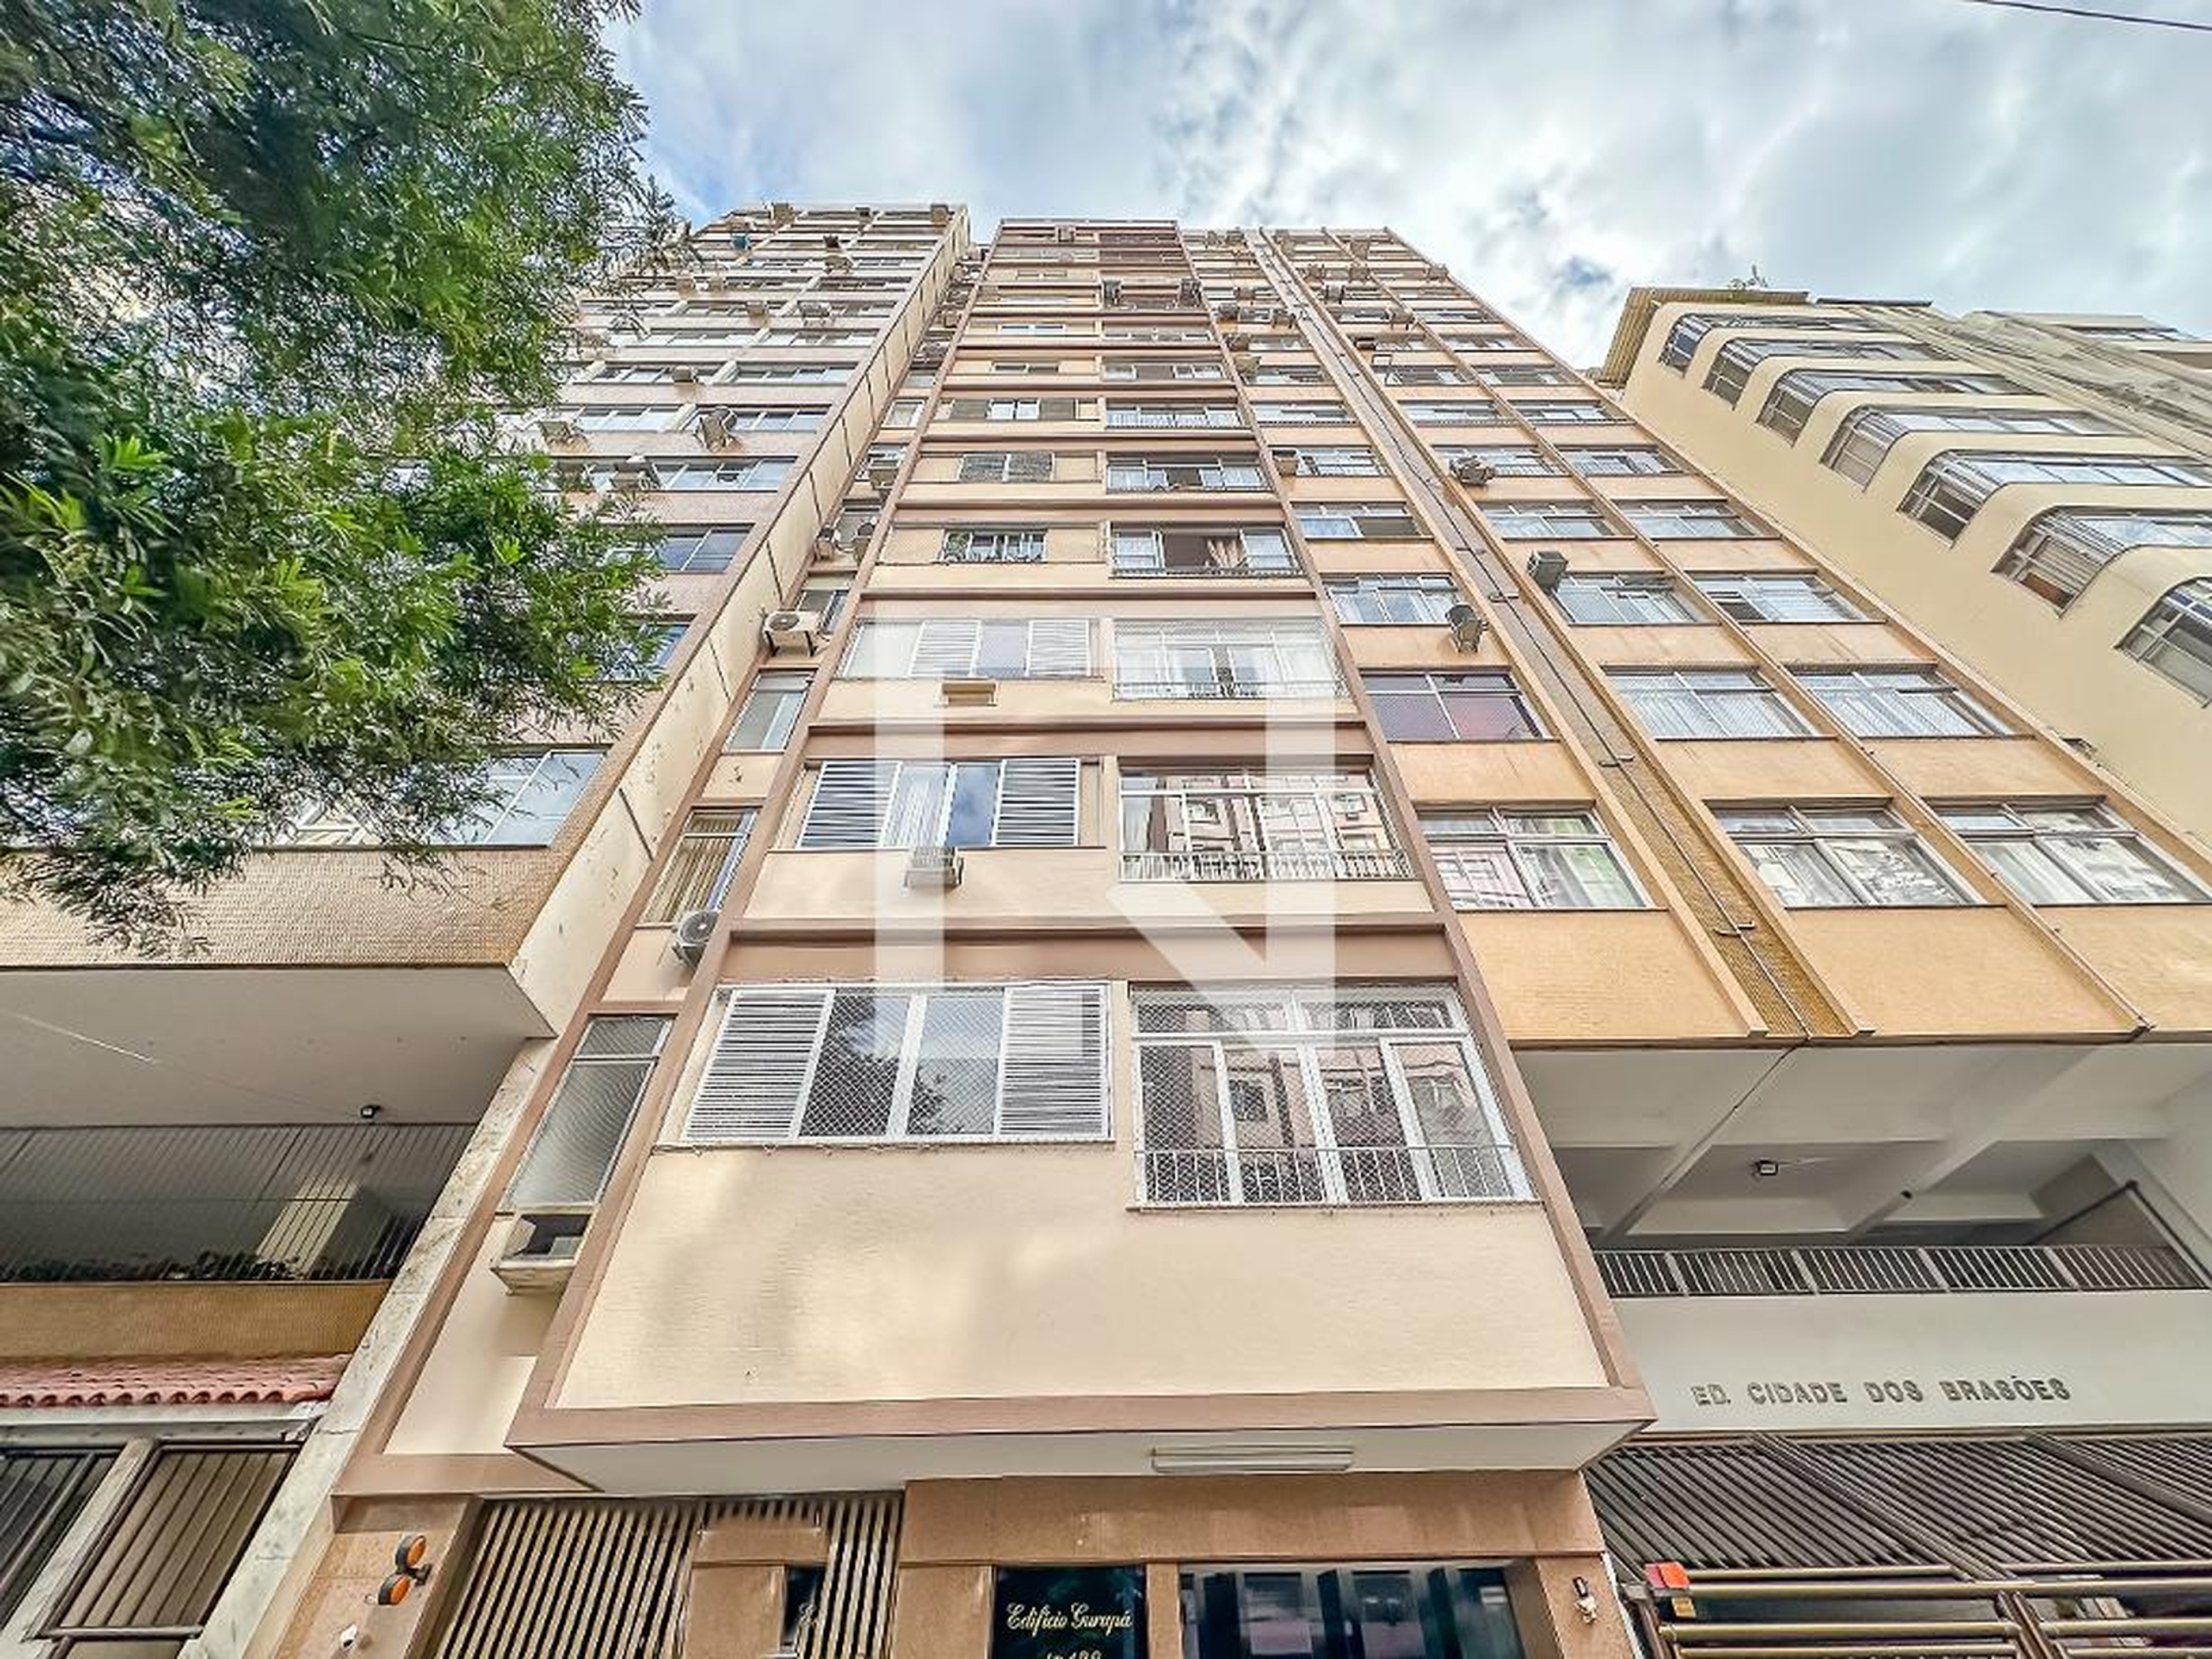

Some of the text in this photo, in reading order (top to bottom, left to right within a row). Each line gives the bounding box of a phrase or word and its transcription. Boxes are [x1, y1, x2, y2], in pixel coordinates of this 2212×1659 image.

[1691, 1383, 1731, 1405] ED.
[1747, 1382, 1847, 1404] CIDADE
[1863, 1380, 1923, 1403] DOS
